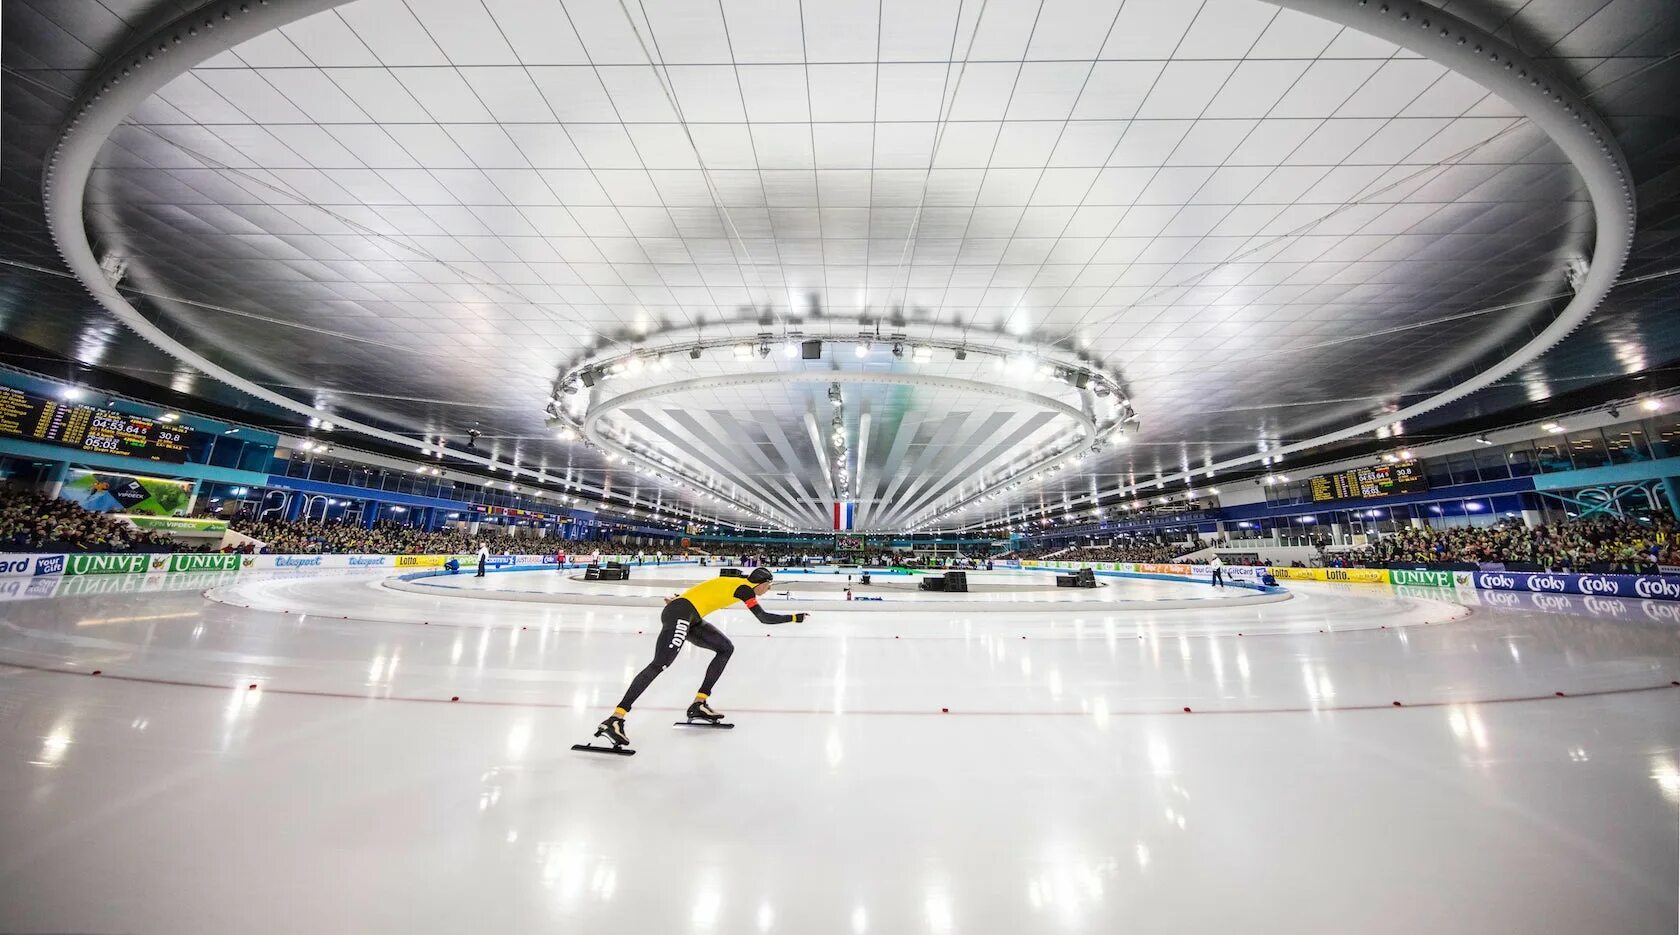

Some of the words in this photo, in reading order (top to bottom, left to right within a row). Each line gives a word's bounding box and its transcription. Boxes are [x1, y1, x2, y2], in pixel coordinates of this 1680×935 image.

[159, 431, 180, 442] 30.8
[166, 521, 197, 529] VIPDECK
[39, 558, 60, 567] Your
[43, 563, 62, 573] Gift
[1326, 570, 1350, 580] Lotto.
[1480, 573, 1514, 589] Croky
[1527, 575, 1565, 591] Croky
[1578, 576, 1618, 594] Croky
[1635, 577, 1680, 598] Croky
[668, 618, 690, 651] Lotto.
